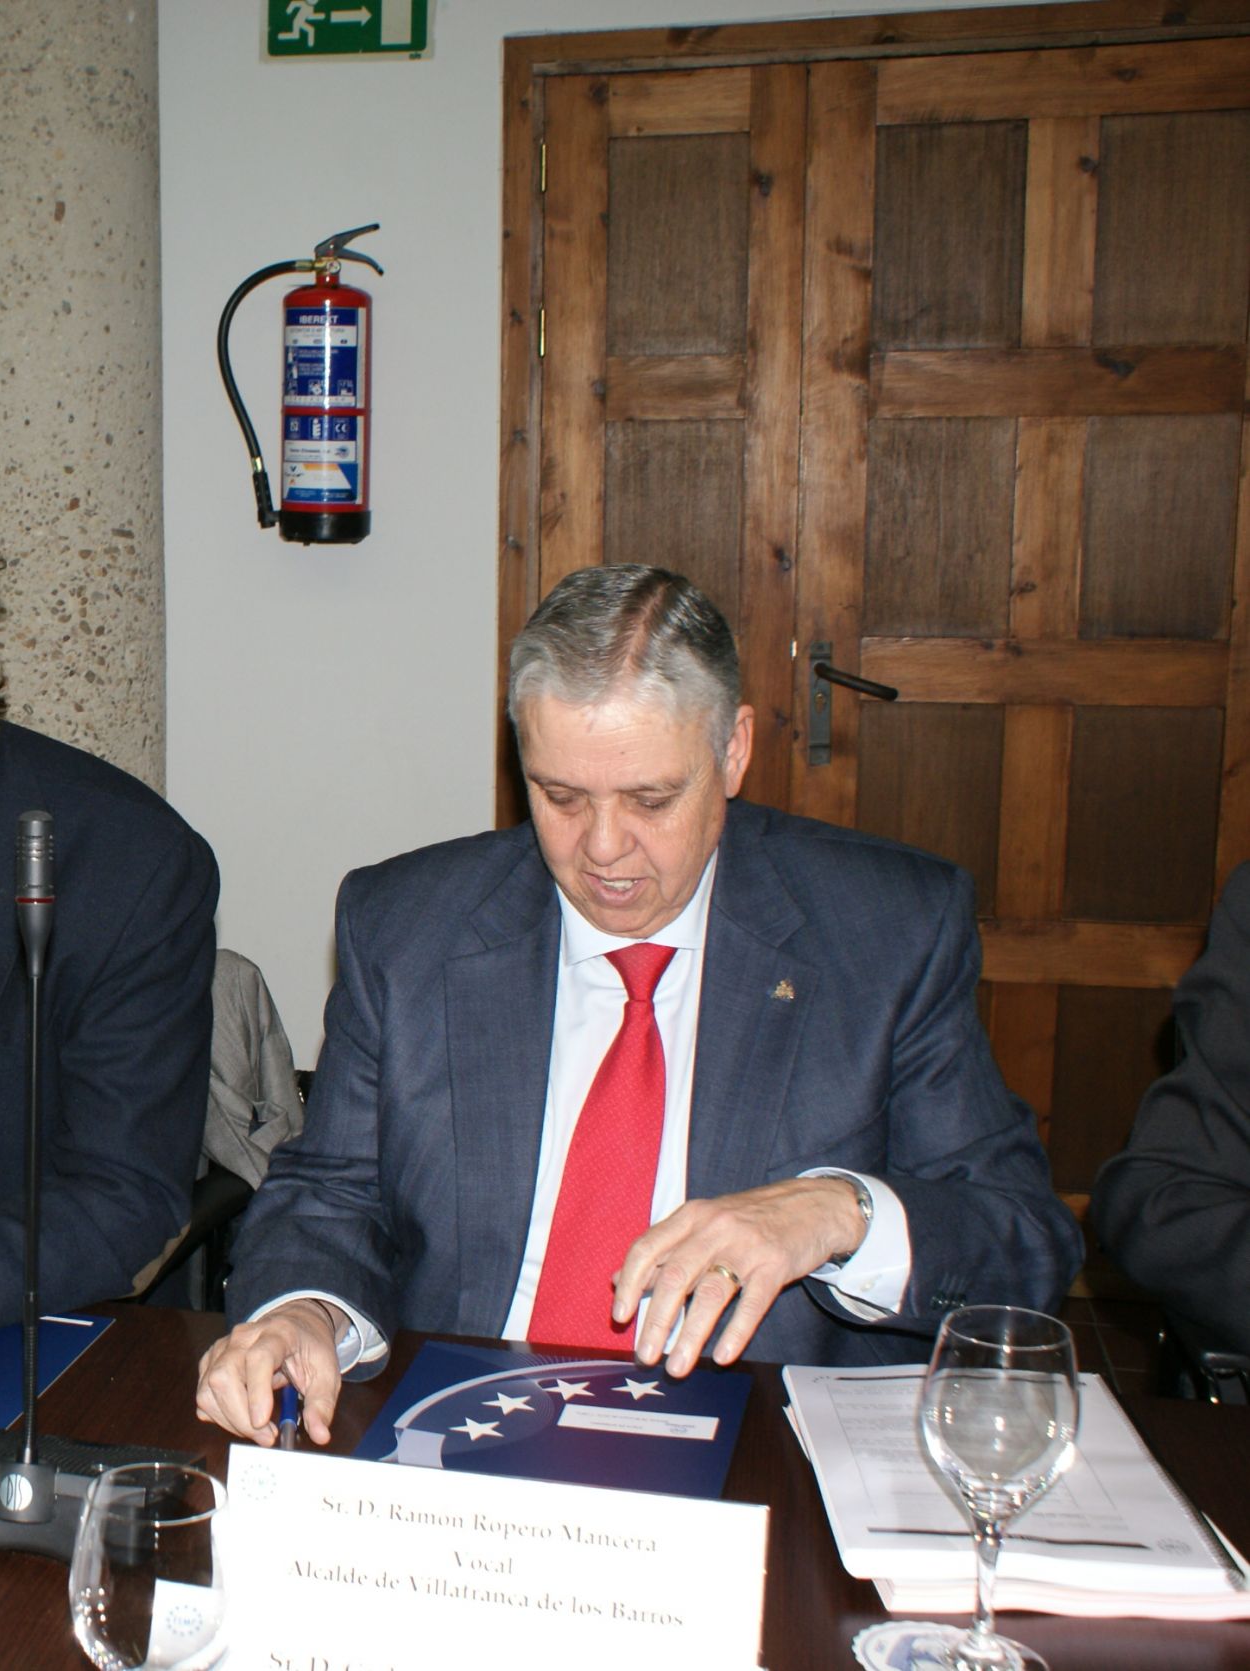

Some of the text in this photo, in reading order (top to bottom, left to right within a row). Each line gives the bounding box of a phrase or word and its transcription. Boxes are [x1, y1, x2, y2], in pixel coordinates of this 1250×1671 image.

[322, 1497, 348, 1513] Sr.
[358, 1500, 380, 1518] D.
[473, 1514, 552, 1540] Ropero
[562, 1524, 657, 1552] Mancera
[454, 1551, 513, 1574] Vocal
[289, 1561, 368, 1585] Alcalde
[375, 1572, 400, 1589] de
[537, 1594, 563, 1611] de
[571, 1597, 602, 1615] los
[612, 1602, 684, 1626] Barros
[310, 1657, 330, 1671] D
